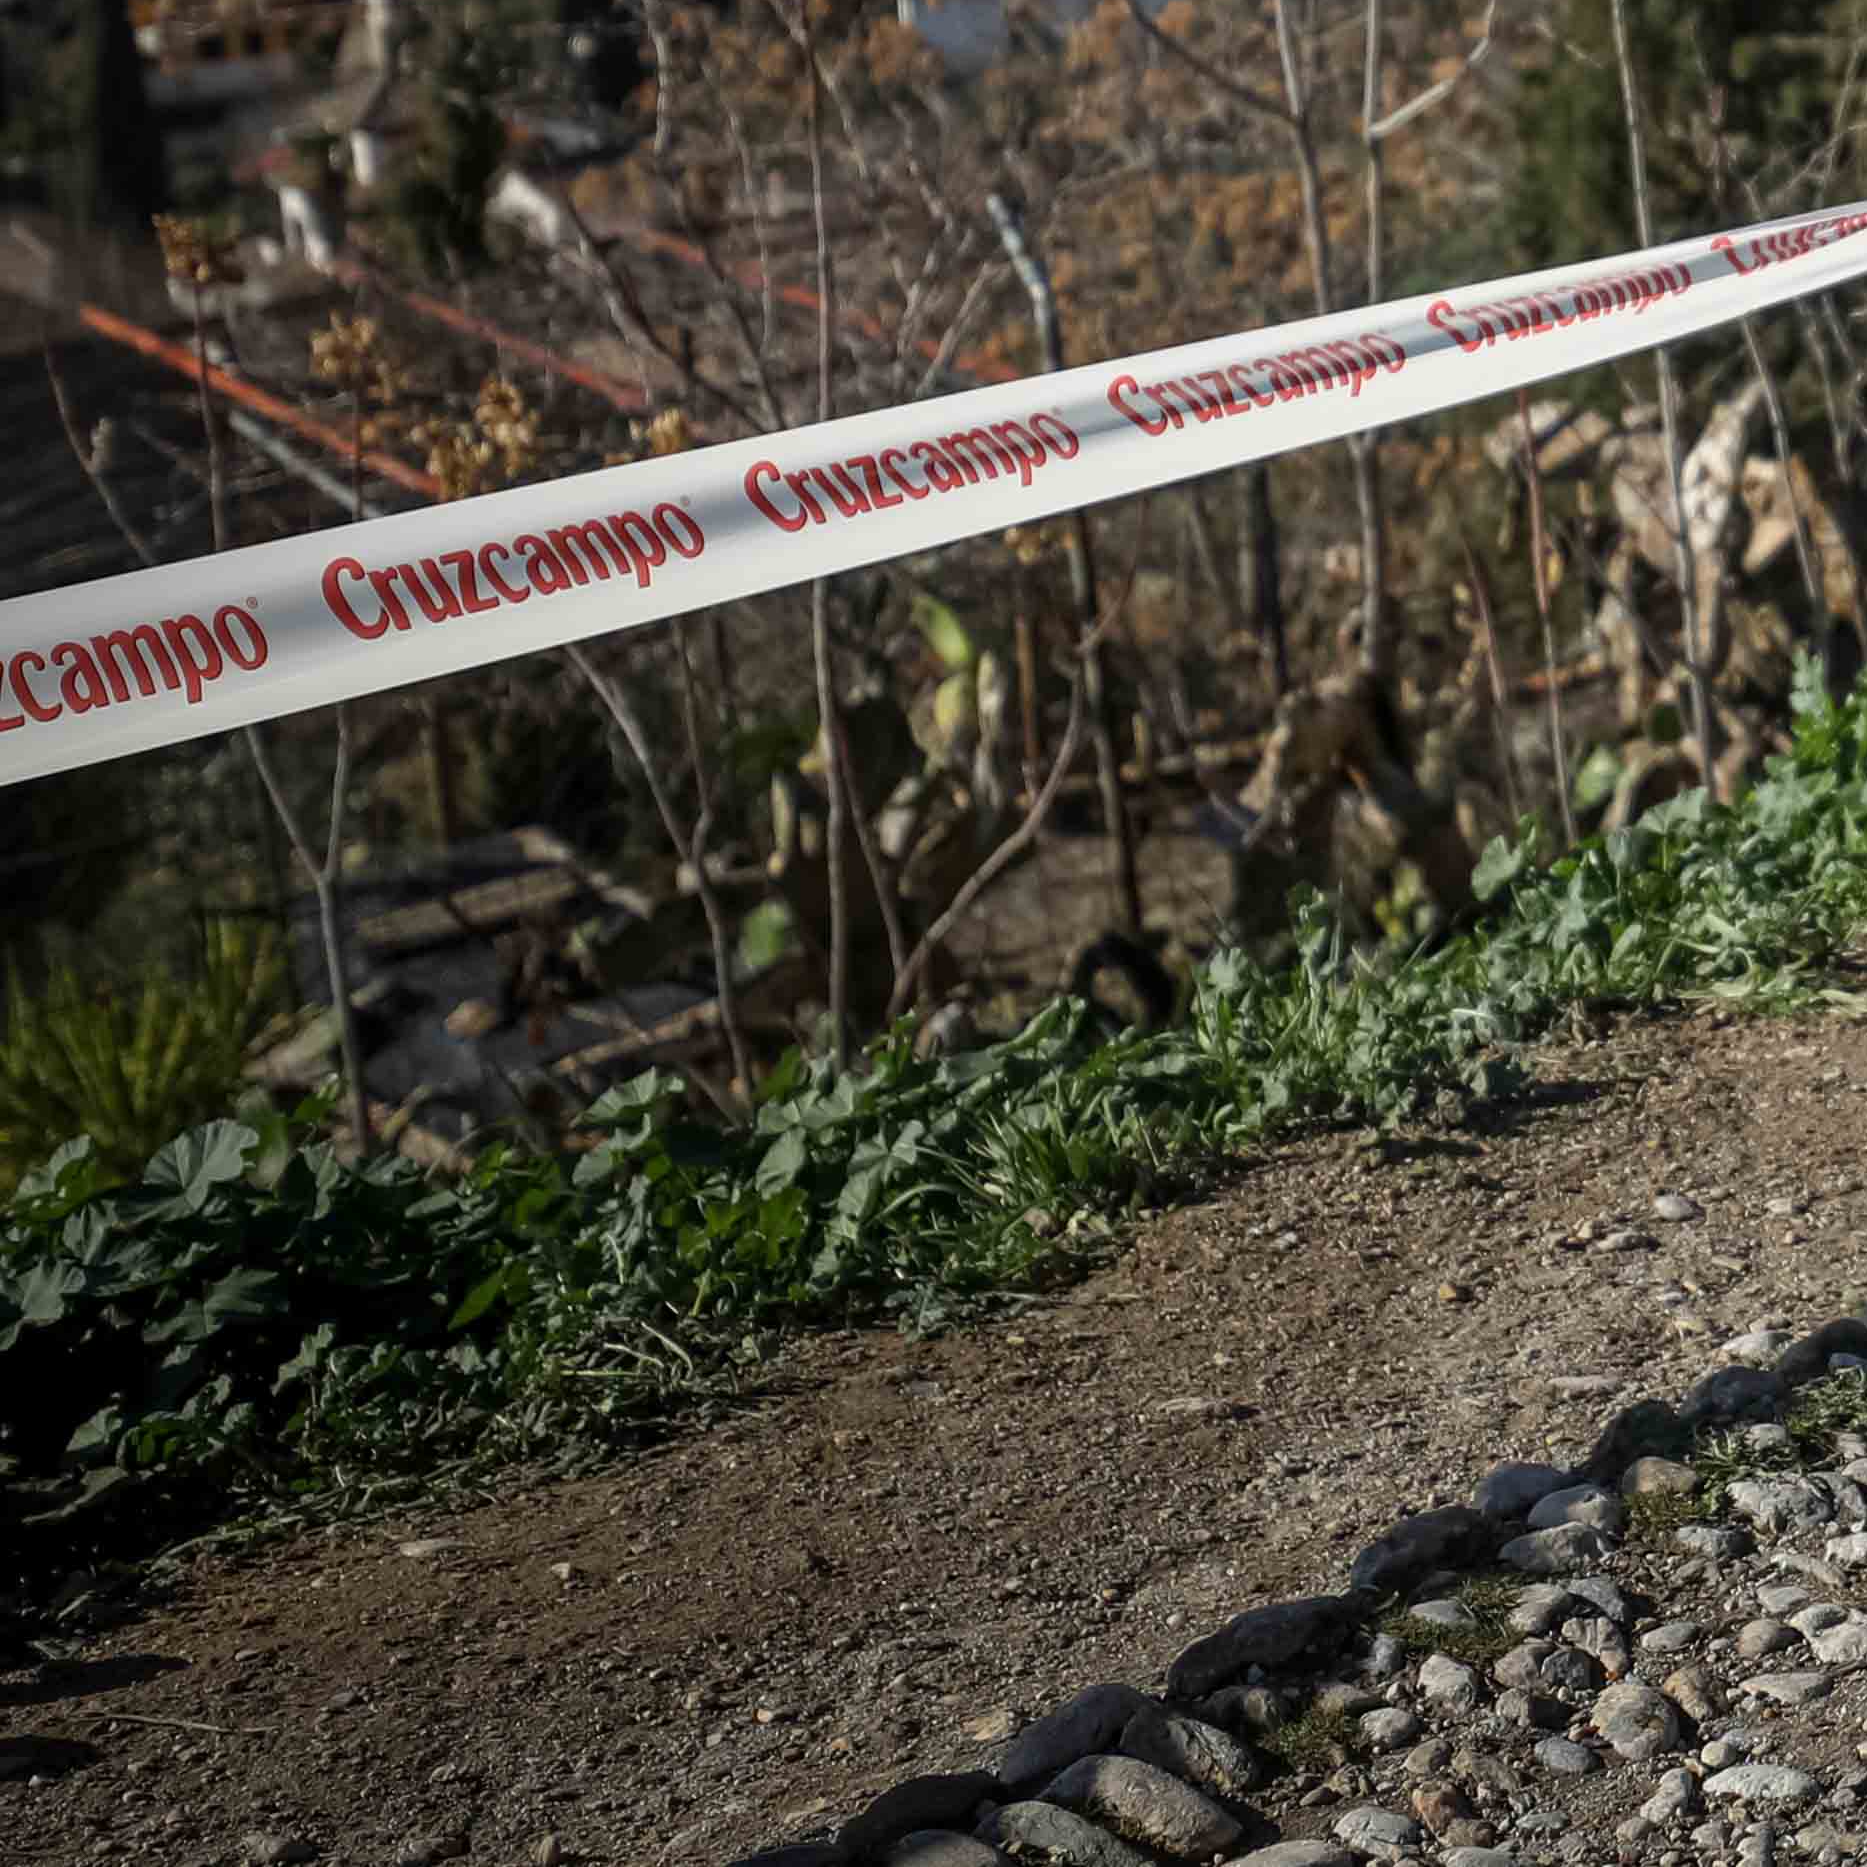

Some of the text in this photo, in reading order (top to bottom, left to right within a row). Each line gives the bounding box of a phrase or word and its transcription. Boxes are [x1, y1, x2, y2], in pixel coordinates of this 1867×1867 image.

[321, 501, 706, 641] Cruzcampo
[743, 410, 1081, 533] Cruzcampo
[1107, 331, 1407, 438] Cruzcampo
[1427, 261, 1693, 354] Cruzcampo
